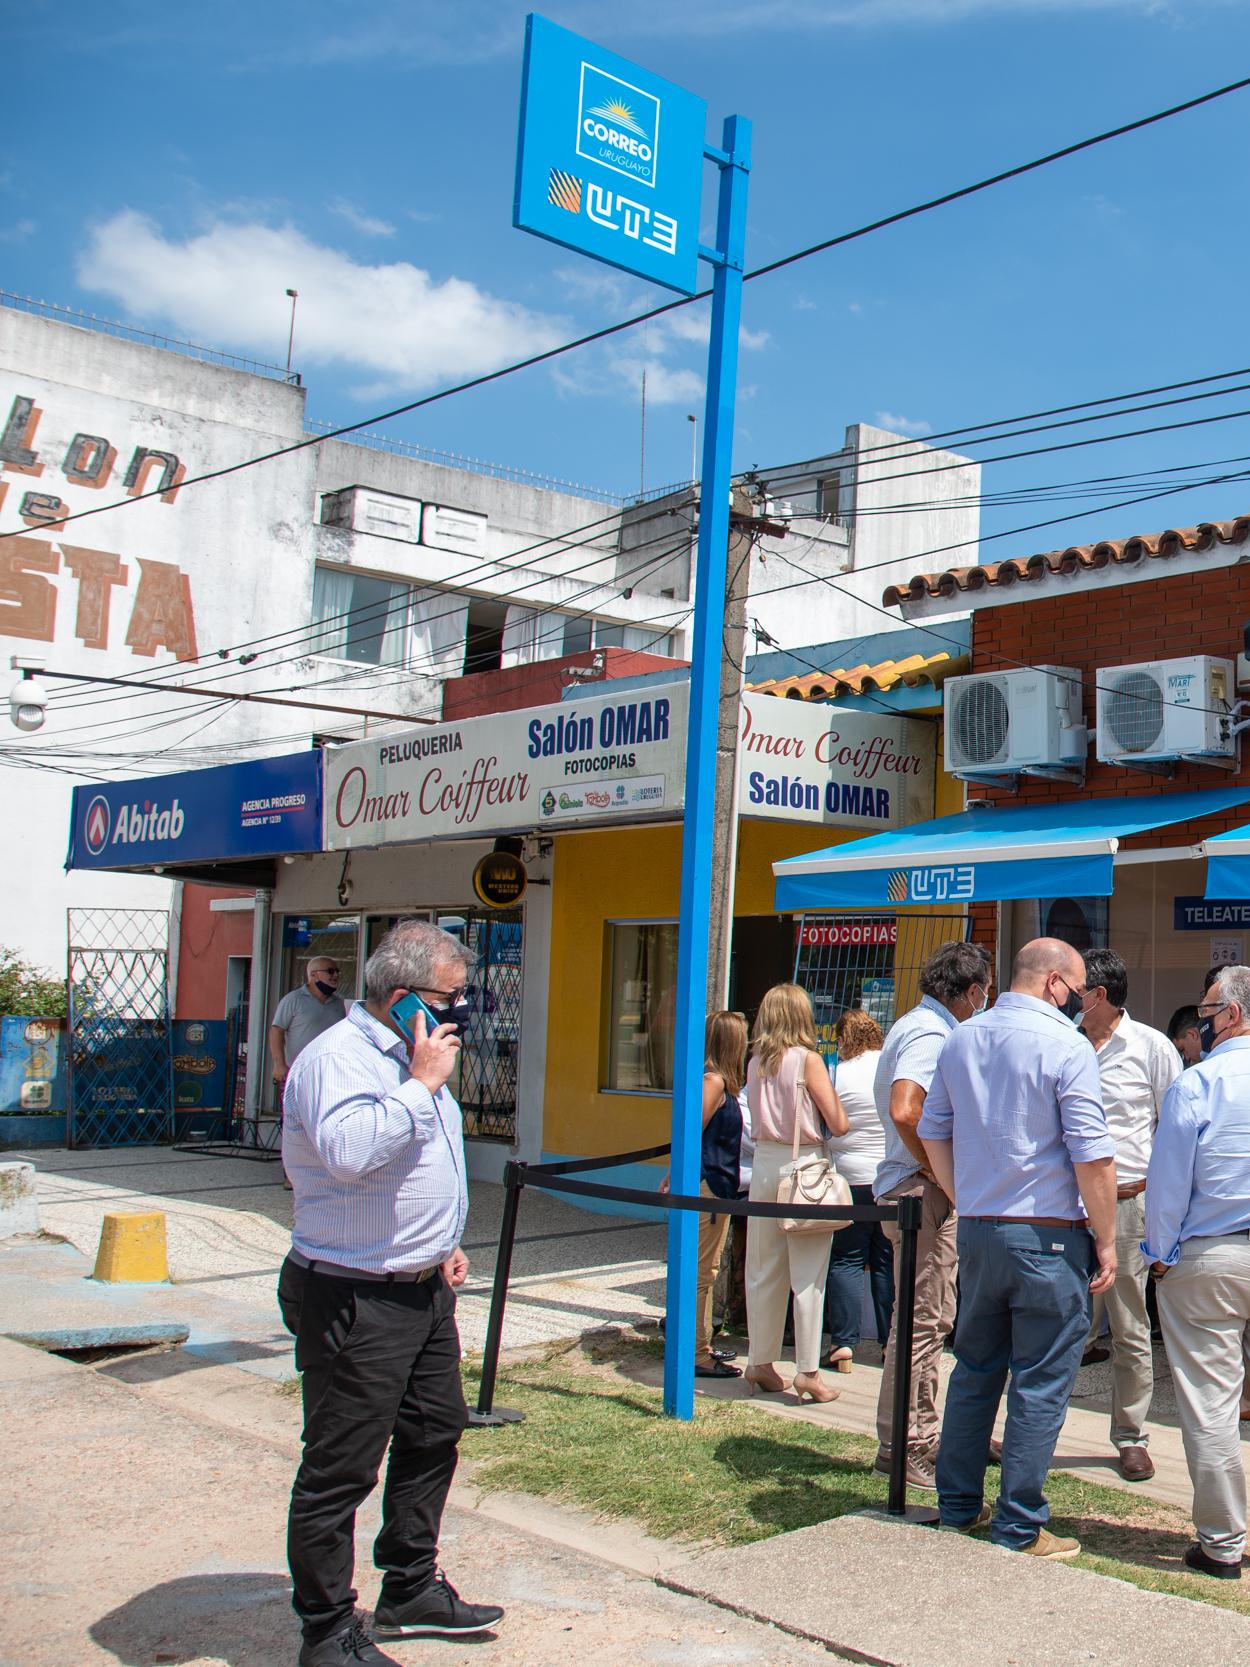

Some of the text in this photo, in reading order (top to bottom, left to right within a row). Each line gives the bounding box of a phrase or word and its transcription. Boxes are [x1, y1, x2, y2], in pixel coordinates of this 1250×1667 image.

[583, 118, 652, 163] CORREO
[598, 146, 651, 178] URUGUAYO
[586, 181, 678, 256] UTE
[379, 731, 463, 766] PELUQUERIA
[527, 698, 671, 760] Salón OMAR
[563, 752, 637, 776] FOTOCOPIAS
[814, 730, 923, 779] Coiffeur
[241, 793, 306, 812] AGENCIA PROGRESO
[335, 756, 531, 829] Omar Coiffeur
[749, 771, 891, 819] Salón OMAR
[112, 799, 186, 845] Abitab
[910, 866, 976, 901] UTE
